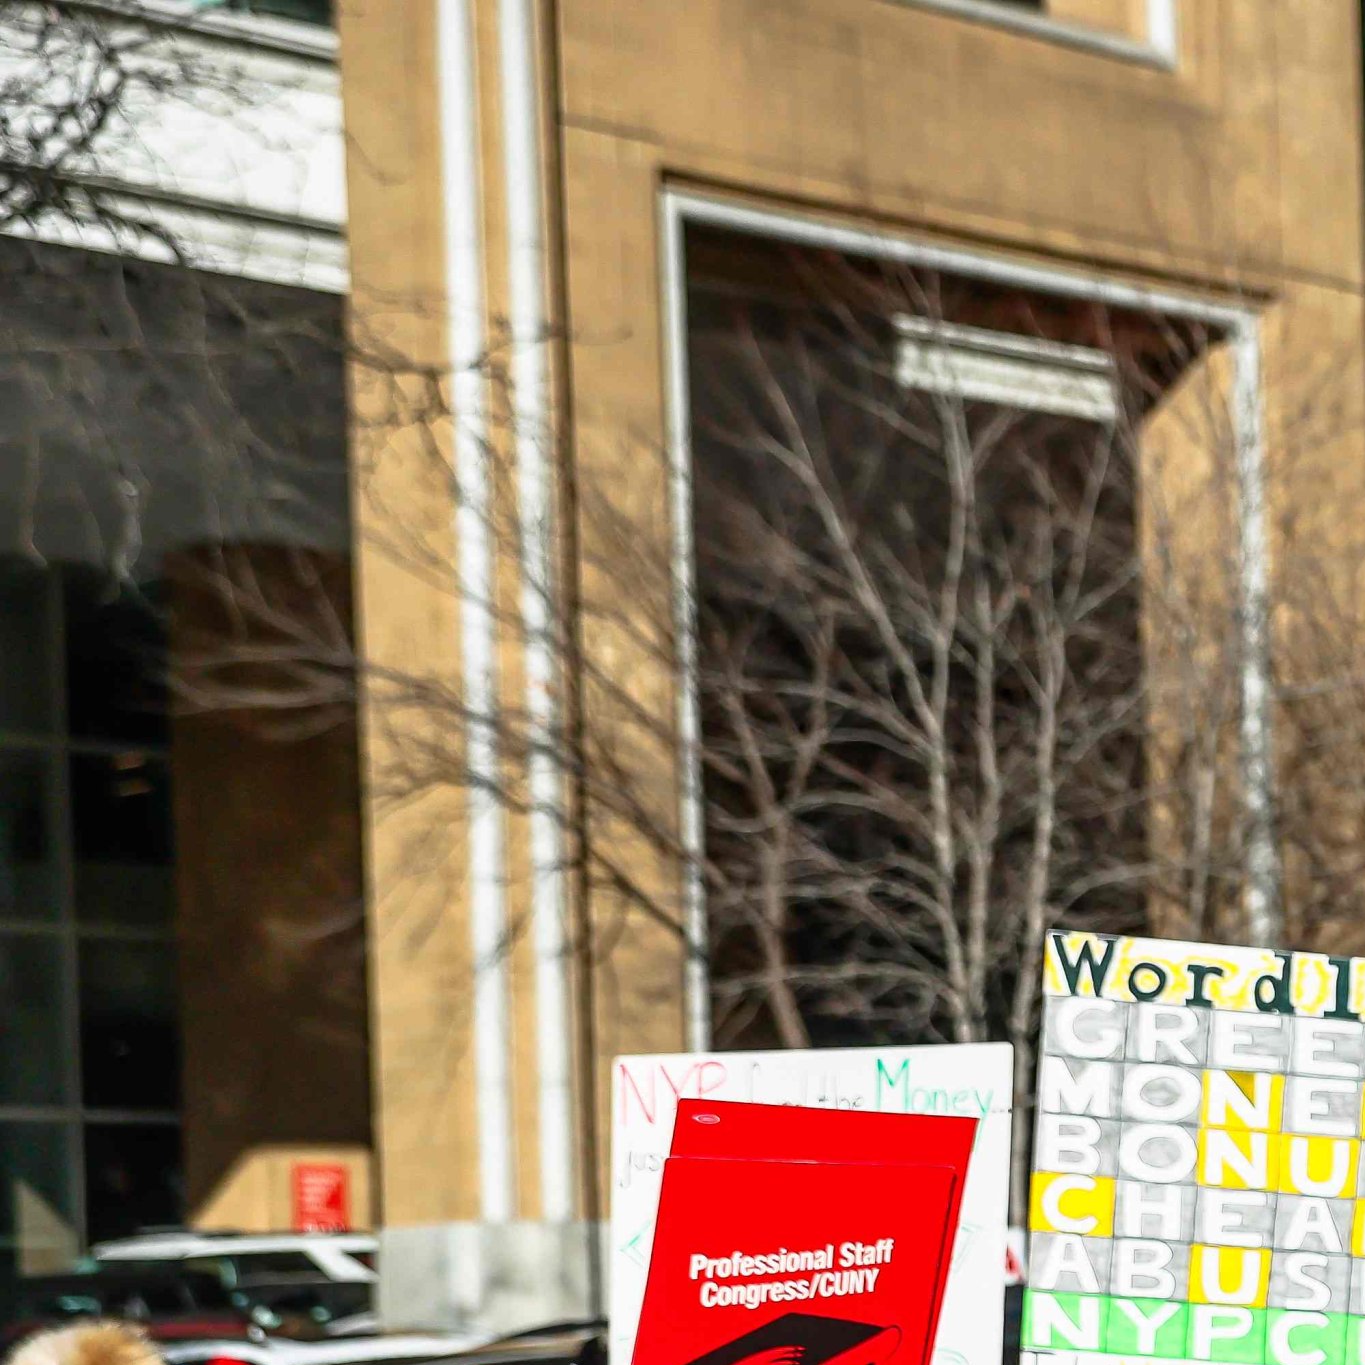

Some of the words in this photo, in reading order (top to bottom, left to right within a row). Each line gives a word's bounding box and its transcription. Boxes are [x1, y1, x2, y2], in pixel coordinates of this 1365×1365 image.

[689, 1253, 833, 1280] Professional
[838, 1237, 895, 1267] Staff
[699, 1267, 880, 1311] Congress/CUNY
